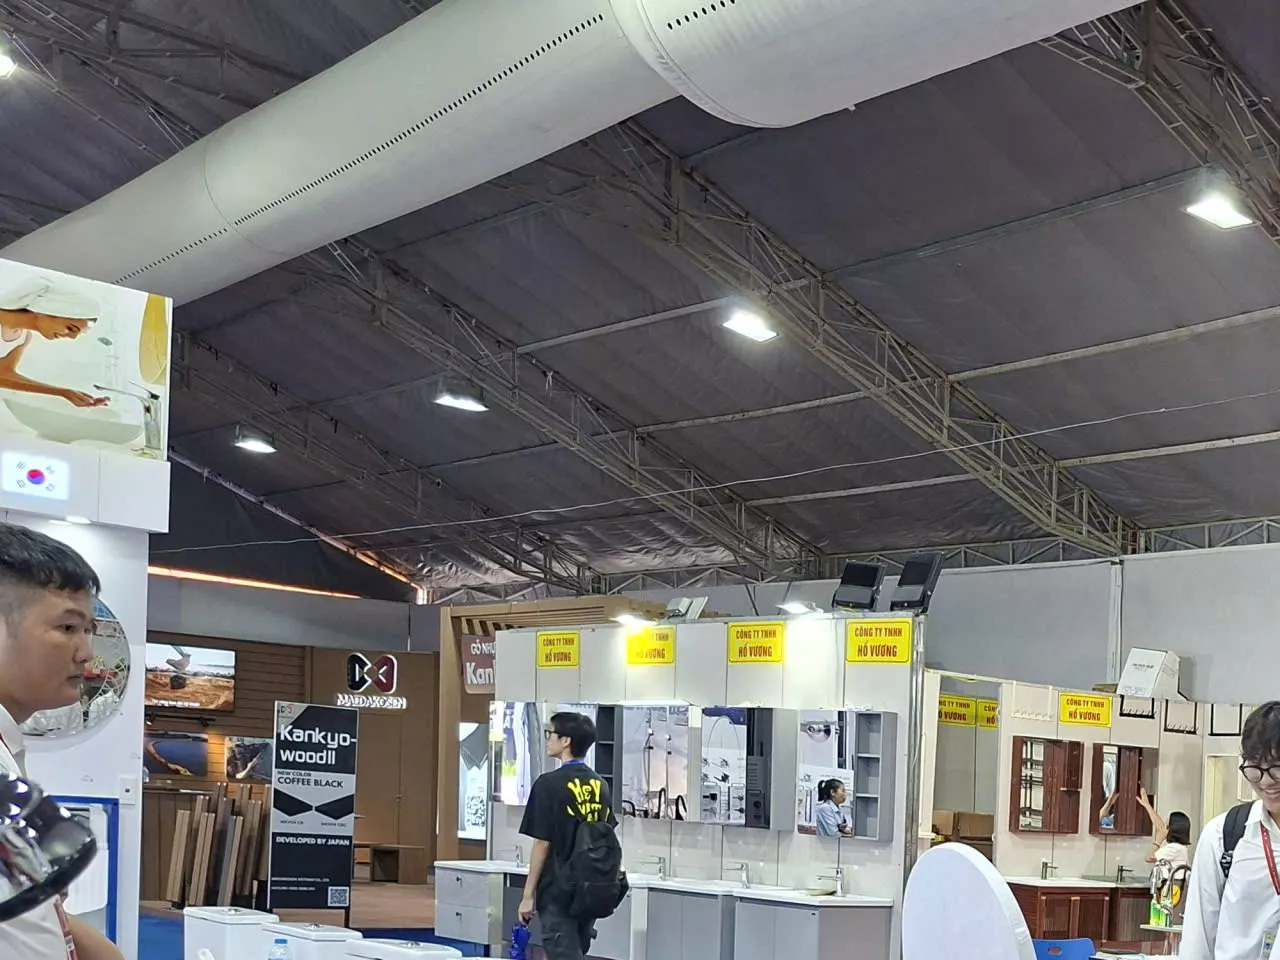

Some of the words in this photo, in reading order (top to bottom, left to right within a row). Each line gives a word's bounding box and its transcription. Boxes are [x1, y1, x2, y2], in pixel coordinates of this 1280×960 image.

[735, 629, 752, 640] CÔNG
[752, 629, 760, 639] TY
[761, 629, 777, 639] TNHH
[855, 626, 873, 637] CÔNG
[874, 627, 882, 637] TY
[884, 627, 903, 638] TNHH
[749, 644, 773, 658] VƯƠNG
[870, 643, 897, 658] VƯƠNG
[466, 660, 496, 685] Kan
[1079, 709, 1101, 722] VƯƠNG
[280, 724, 357, 749] Kankyo-
[277, 776, 312, 787] COFFEE
[313, 778, 344, 789] BLACK
[275, 836, 316, 845] DEVELOPED
[317, 837, 327, 845] BY
[327, 838, 350, 846] JAPAN
